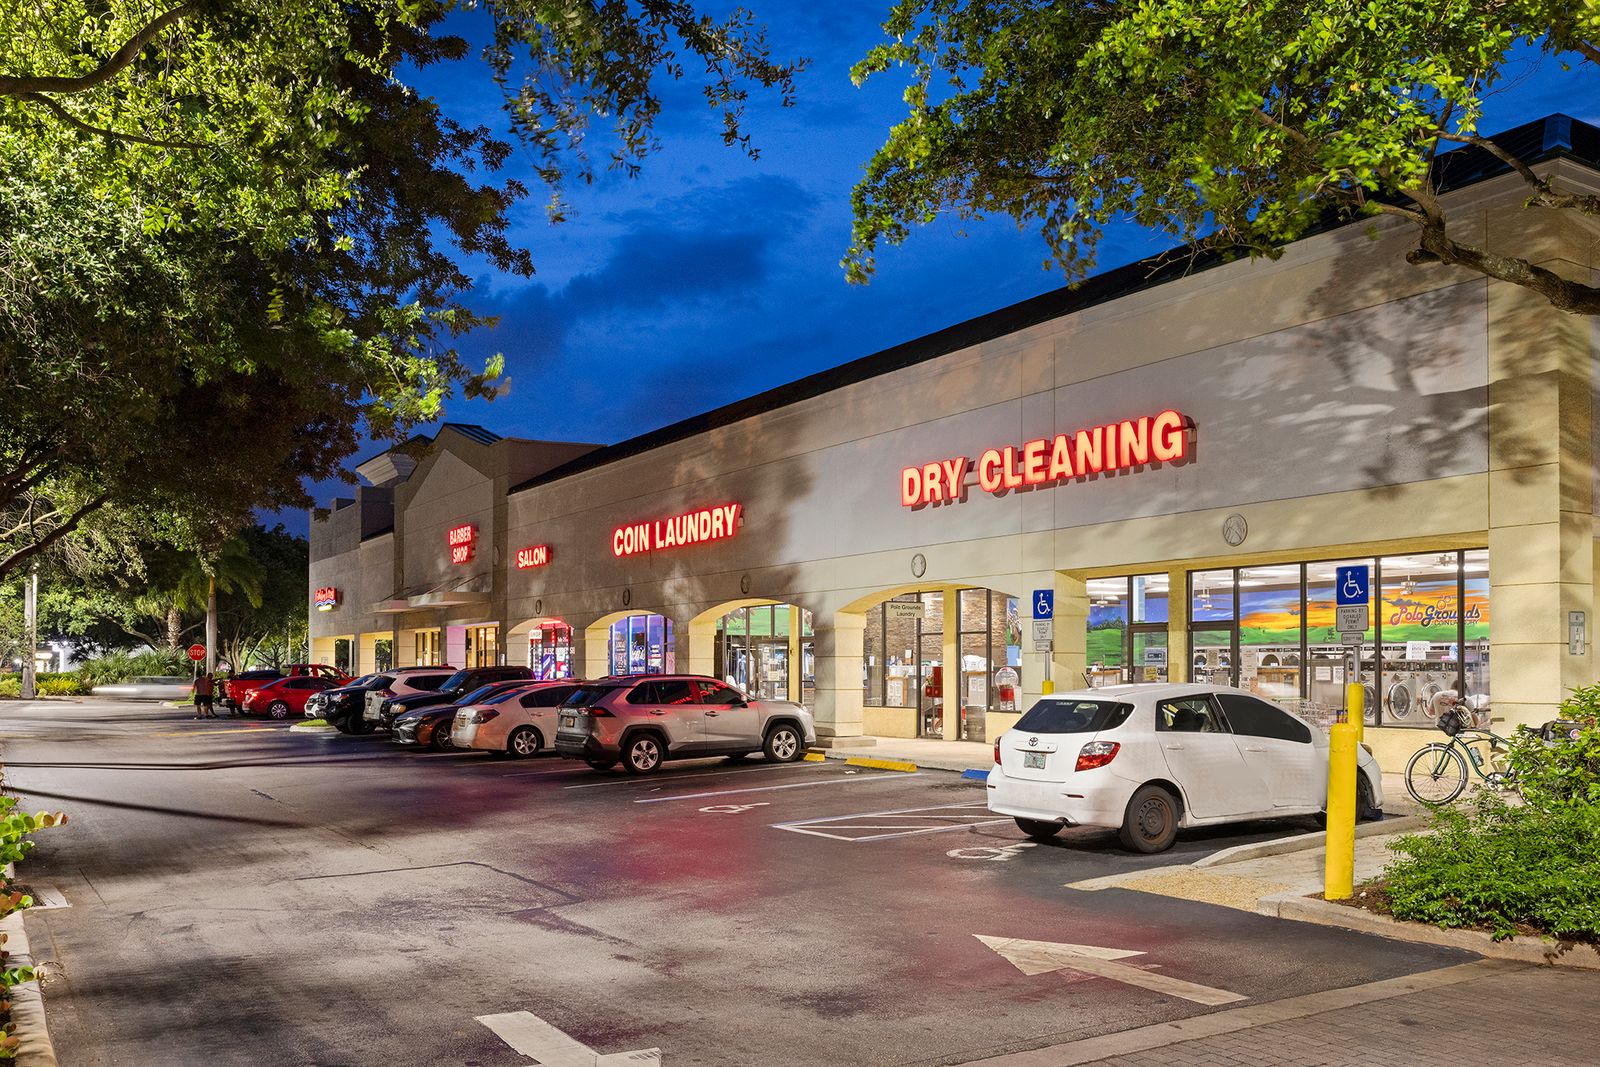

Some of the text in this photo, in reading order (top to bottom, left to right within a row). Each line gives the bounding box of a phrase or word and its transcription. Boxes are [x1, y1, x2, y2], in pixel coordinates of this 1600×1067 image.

[902, 409, 1185, 507] DRY CLEANING
[449, 525, 472, 546] BARBER
[612, 504, 738, 557] COIN LAUNDRY
[452, 545, 469, 563] SHOP
[518, 546, 547, 568] SALON
[1390, 604, 1480, 627] Polo Grouds
